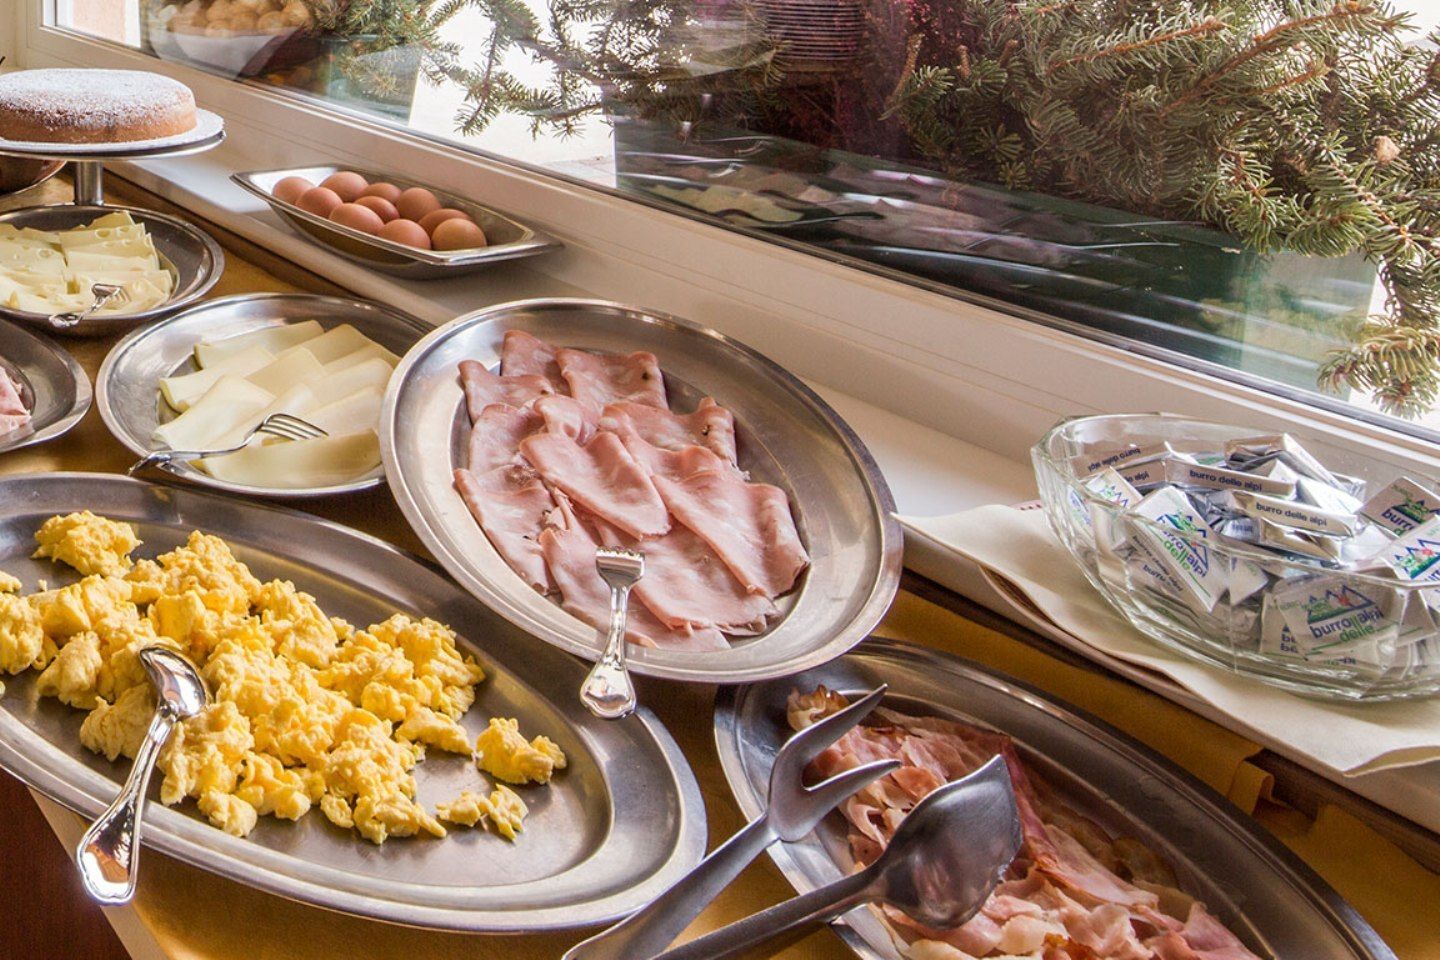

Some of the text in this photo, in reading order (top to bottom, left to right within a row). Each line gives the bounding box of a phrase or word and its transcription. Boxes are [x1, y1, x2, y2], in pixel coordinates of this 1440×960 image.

[1189, 469, 1262, 491] burro delle alpi
[1255, 502, 1328, 527] burro delle alpi
[1163, 539, 1191, 571] delle
[1186, 553, 1208, 578] alpi
[1356, 604, 1385, 624] alpi
[1309, 617, 1352, 639] burro
[1339, 614, 1375, 643] delle
